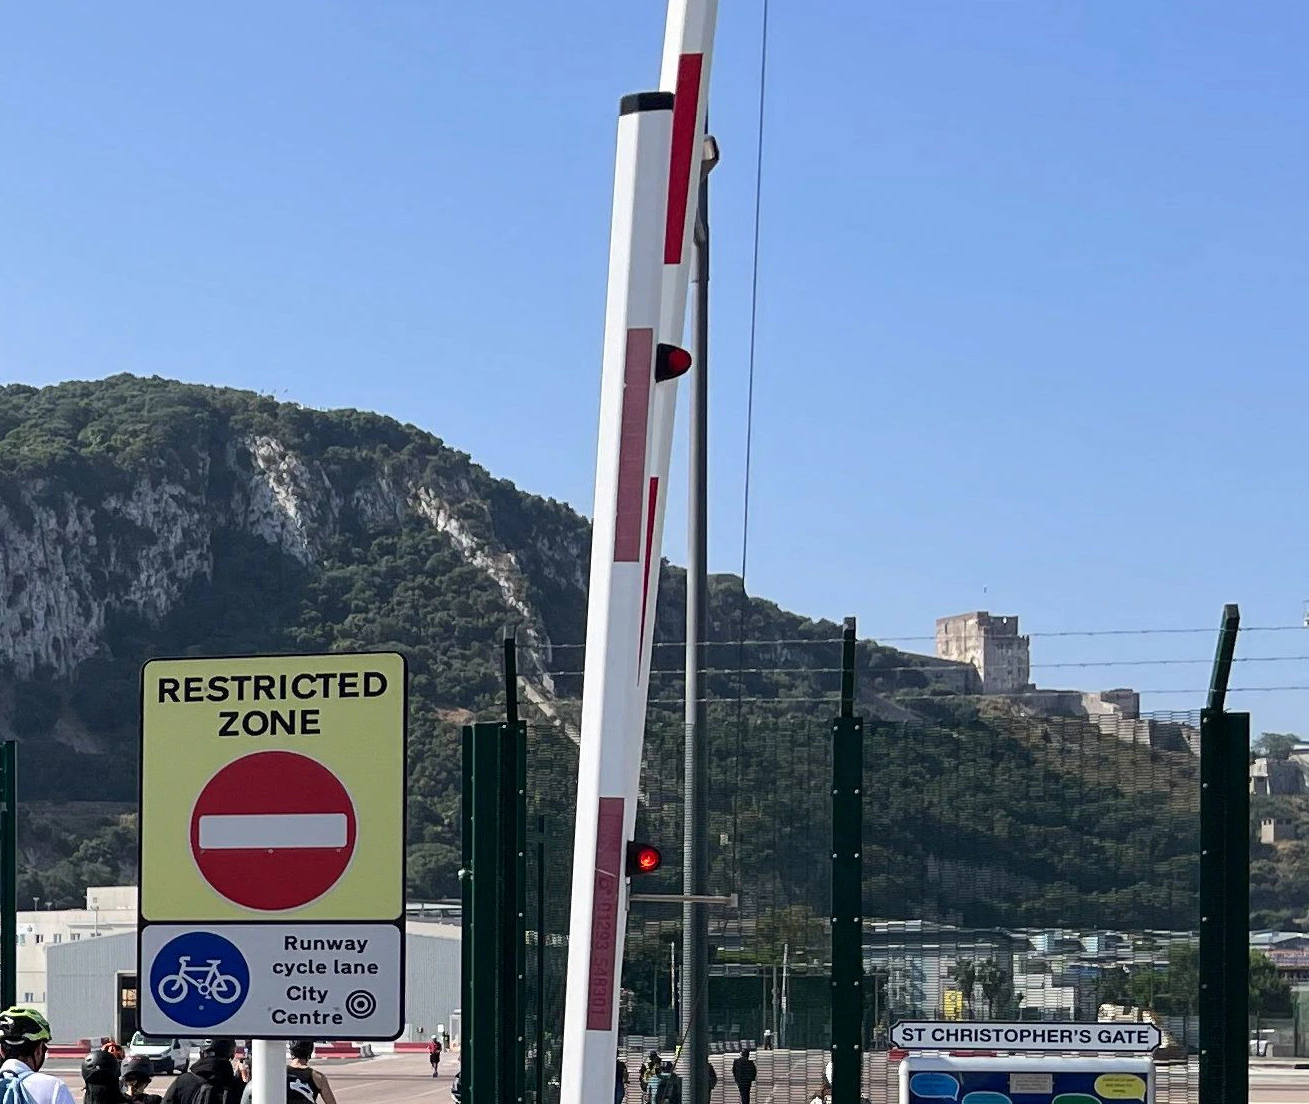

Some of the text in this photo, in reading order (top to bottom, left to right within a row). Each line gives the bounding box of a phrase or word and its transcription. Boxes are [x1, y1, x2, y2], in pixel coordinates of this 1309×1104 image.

[158, 671, 387, 703] RESTRICTED
[218, 709, 321, 737] ZONE
[284, 936, 368, 954] Runway
[272, 960, 379, 976] cycle lane
[286, 985, 328, 1004] City
[272, 1009, 343, 1025] Centre
[902, 1028, 1149, 1044] ST CHRISTOPHER'S GATE
